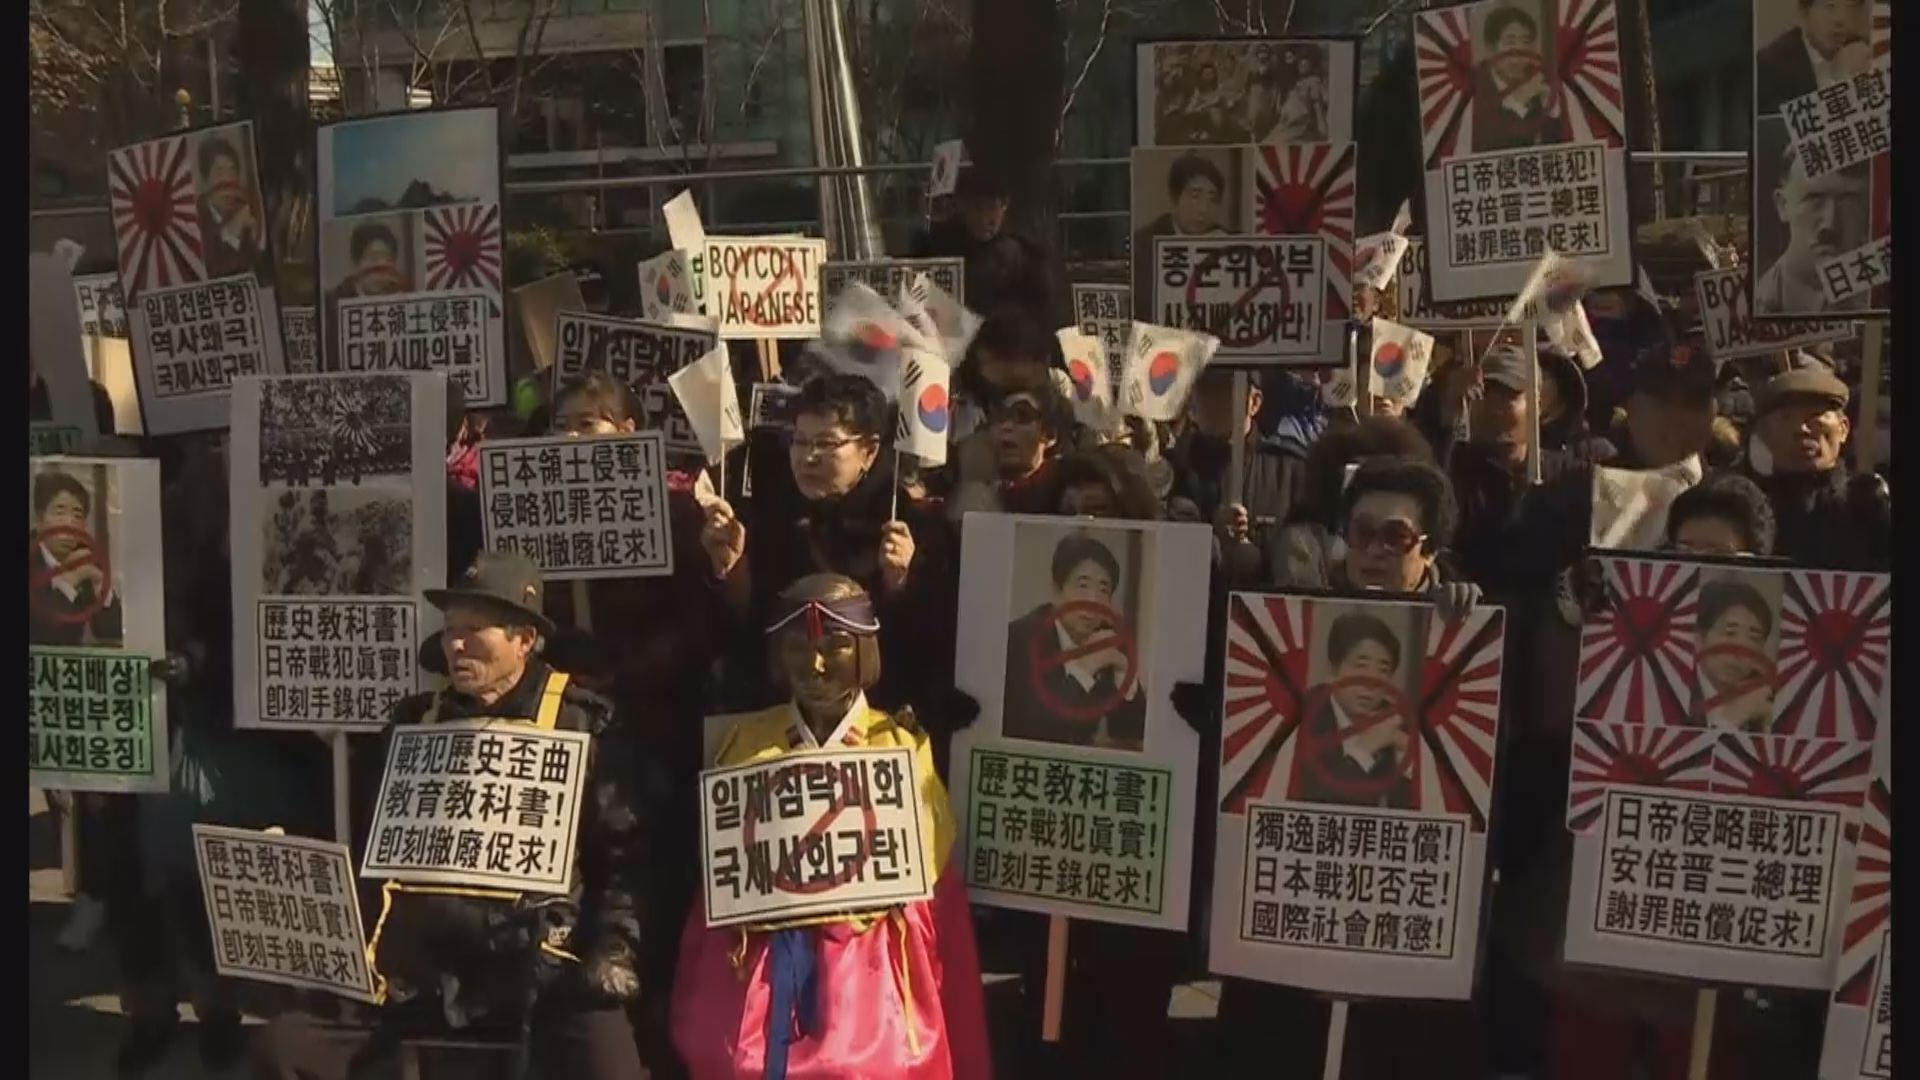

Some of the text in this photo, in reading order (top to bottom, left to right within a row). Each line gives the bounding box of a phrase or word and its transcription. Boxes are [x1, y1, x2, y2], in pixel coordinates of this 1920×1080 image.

[1788, 67, 1890, 139] 從軍慰
[1799, 112, 1890, 178] 謝罪賠
[1162, 246, 1314, 287] 종군위안부
[151, 317, 258, 358] 역사왜곡!
[490, 444, 650, 487] 日本領土侵奪!
[490, 487, 655, 528] 侵略犯罪否定!
[712, 759, 903, 830] 일제침략미화
[713, 829, 911, 898] 국제사회규탄!
[1254, 855, 1450, 908] 日本戰犯否定!
